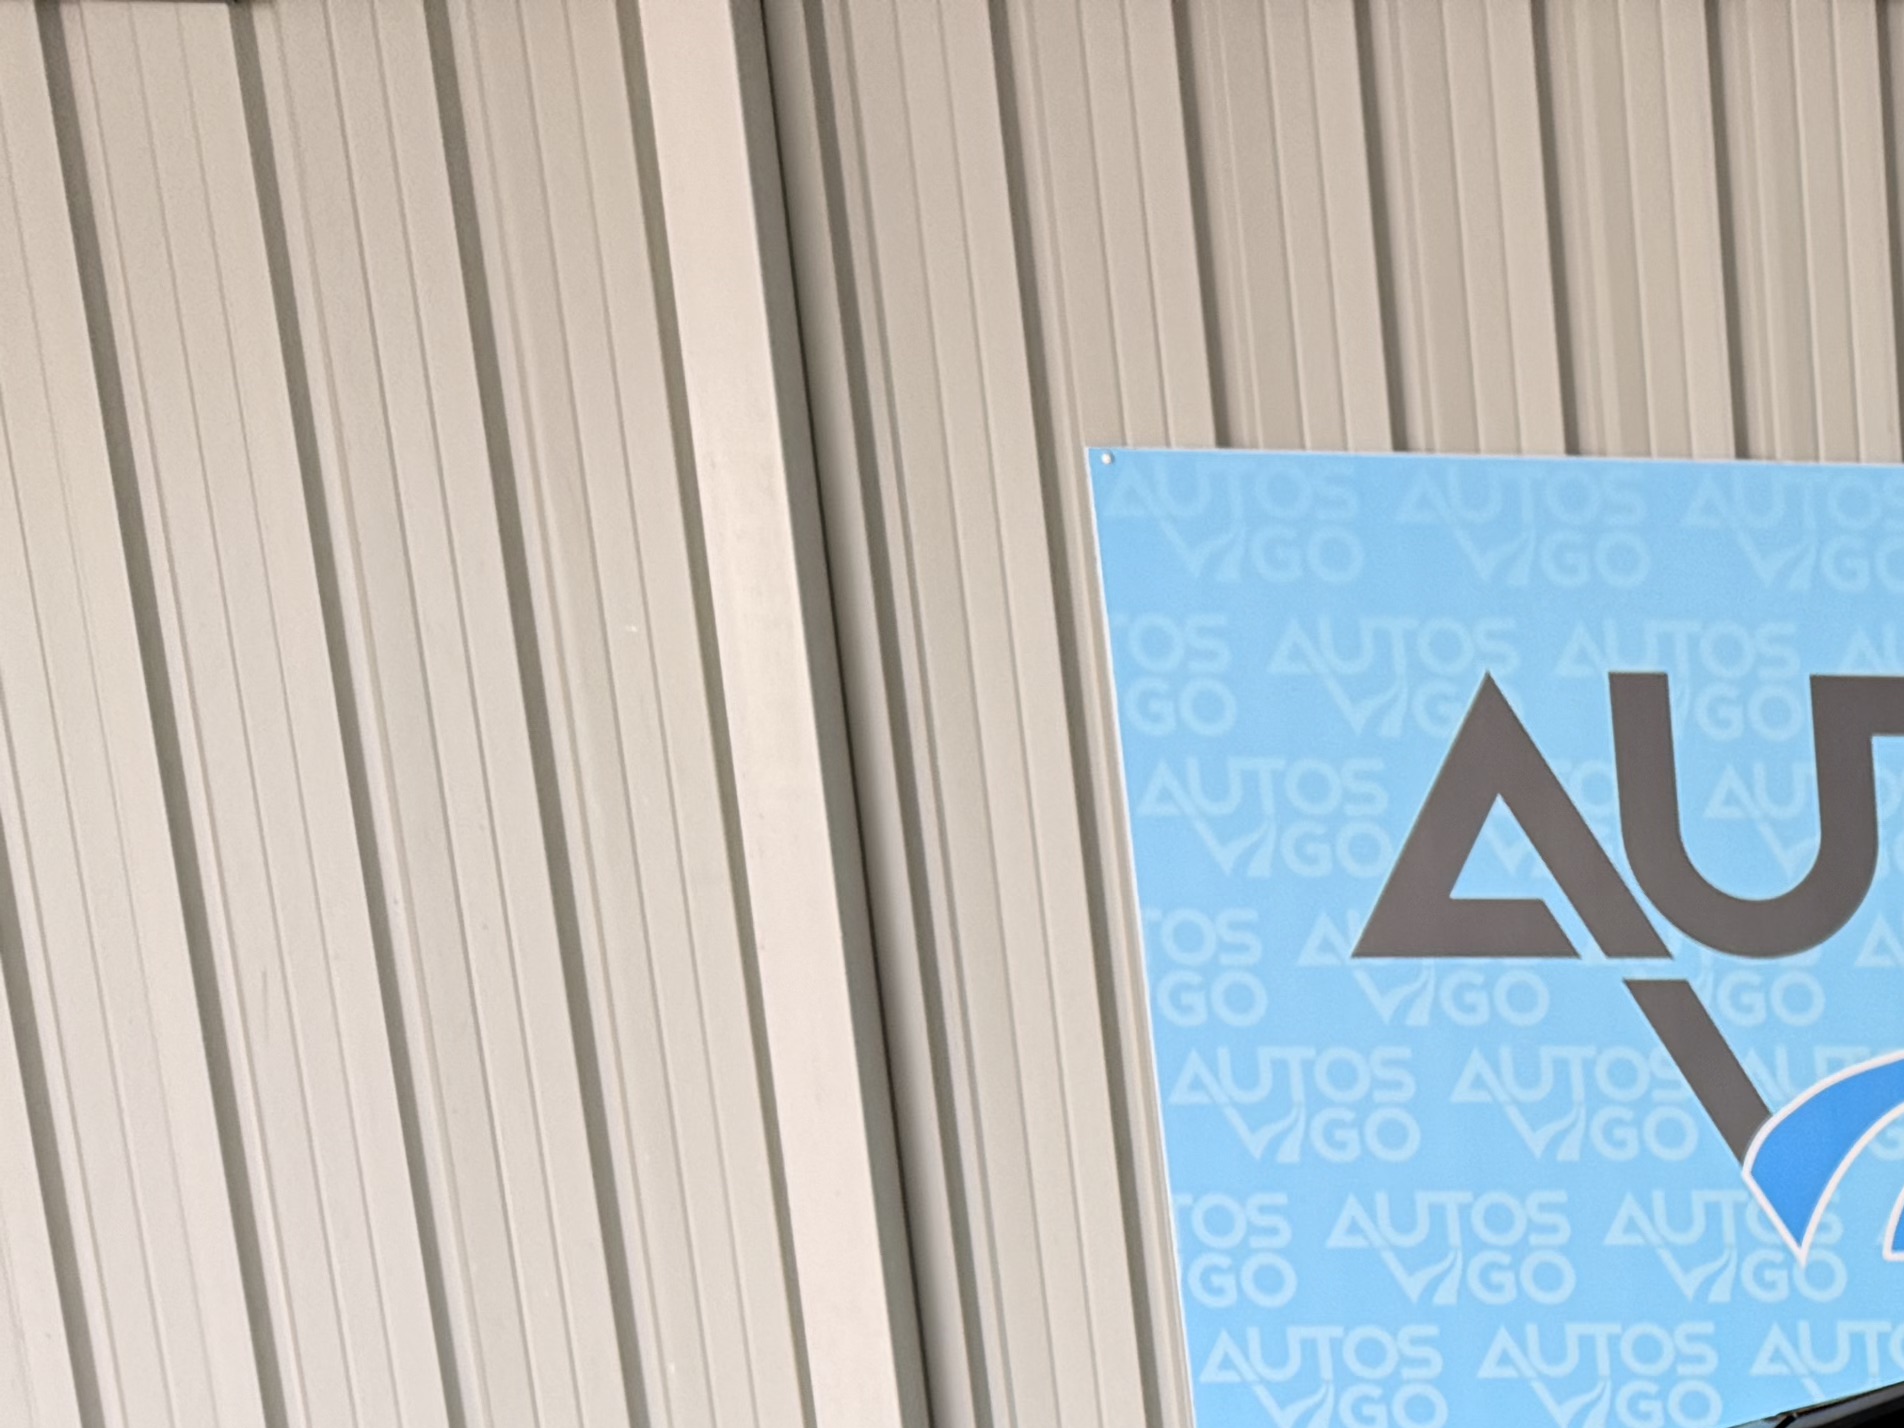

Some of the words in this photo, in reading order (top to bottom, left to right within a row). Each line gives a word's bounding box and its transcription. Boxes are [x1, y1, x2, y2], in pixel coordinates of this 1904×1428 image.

[1105, 465, 1359, 521] AUTOS
[1394, 466, 1647, 526] AUTOS
[1157, 521, 1365, 584] VIGO
[1449, 525, 1651, 589] VIGO
[1115, 612, 1232, 674] OS
[1267, 613, 1521, 677] AUTOS
[1555, 617, 1800, 679] AUTOS
[1315, 675, 1524, 739] VIG
[1137, 755, 1390, 817] AUTOS
[1168, 1047, 1416, 1105] AUTOS
[1221, 1105, 1421, 1163] VIGO
[1503, 1104, 1698, 1164] VIGO
[1326, 1190, 1572, 1248] AUTOS
[1379, 1247, 1578, 1307] VIGO
[1657, 1247, 1849, 1303] VIGO
[1198, 1324, 1445, 1383] AUTOS
[1475, 1320, 1719, 1379] AUTOS
